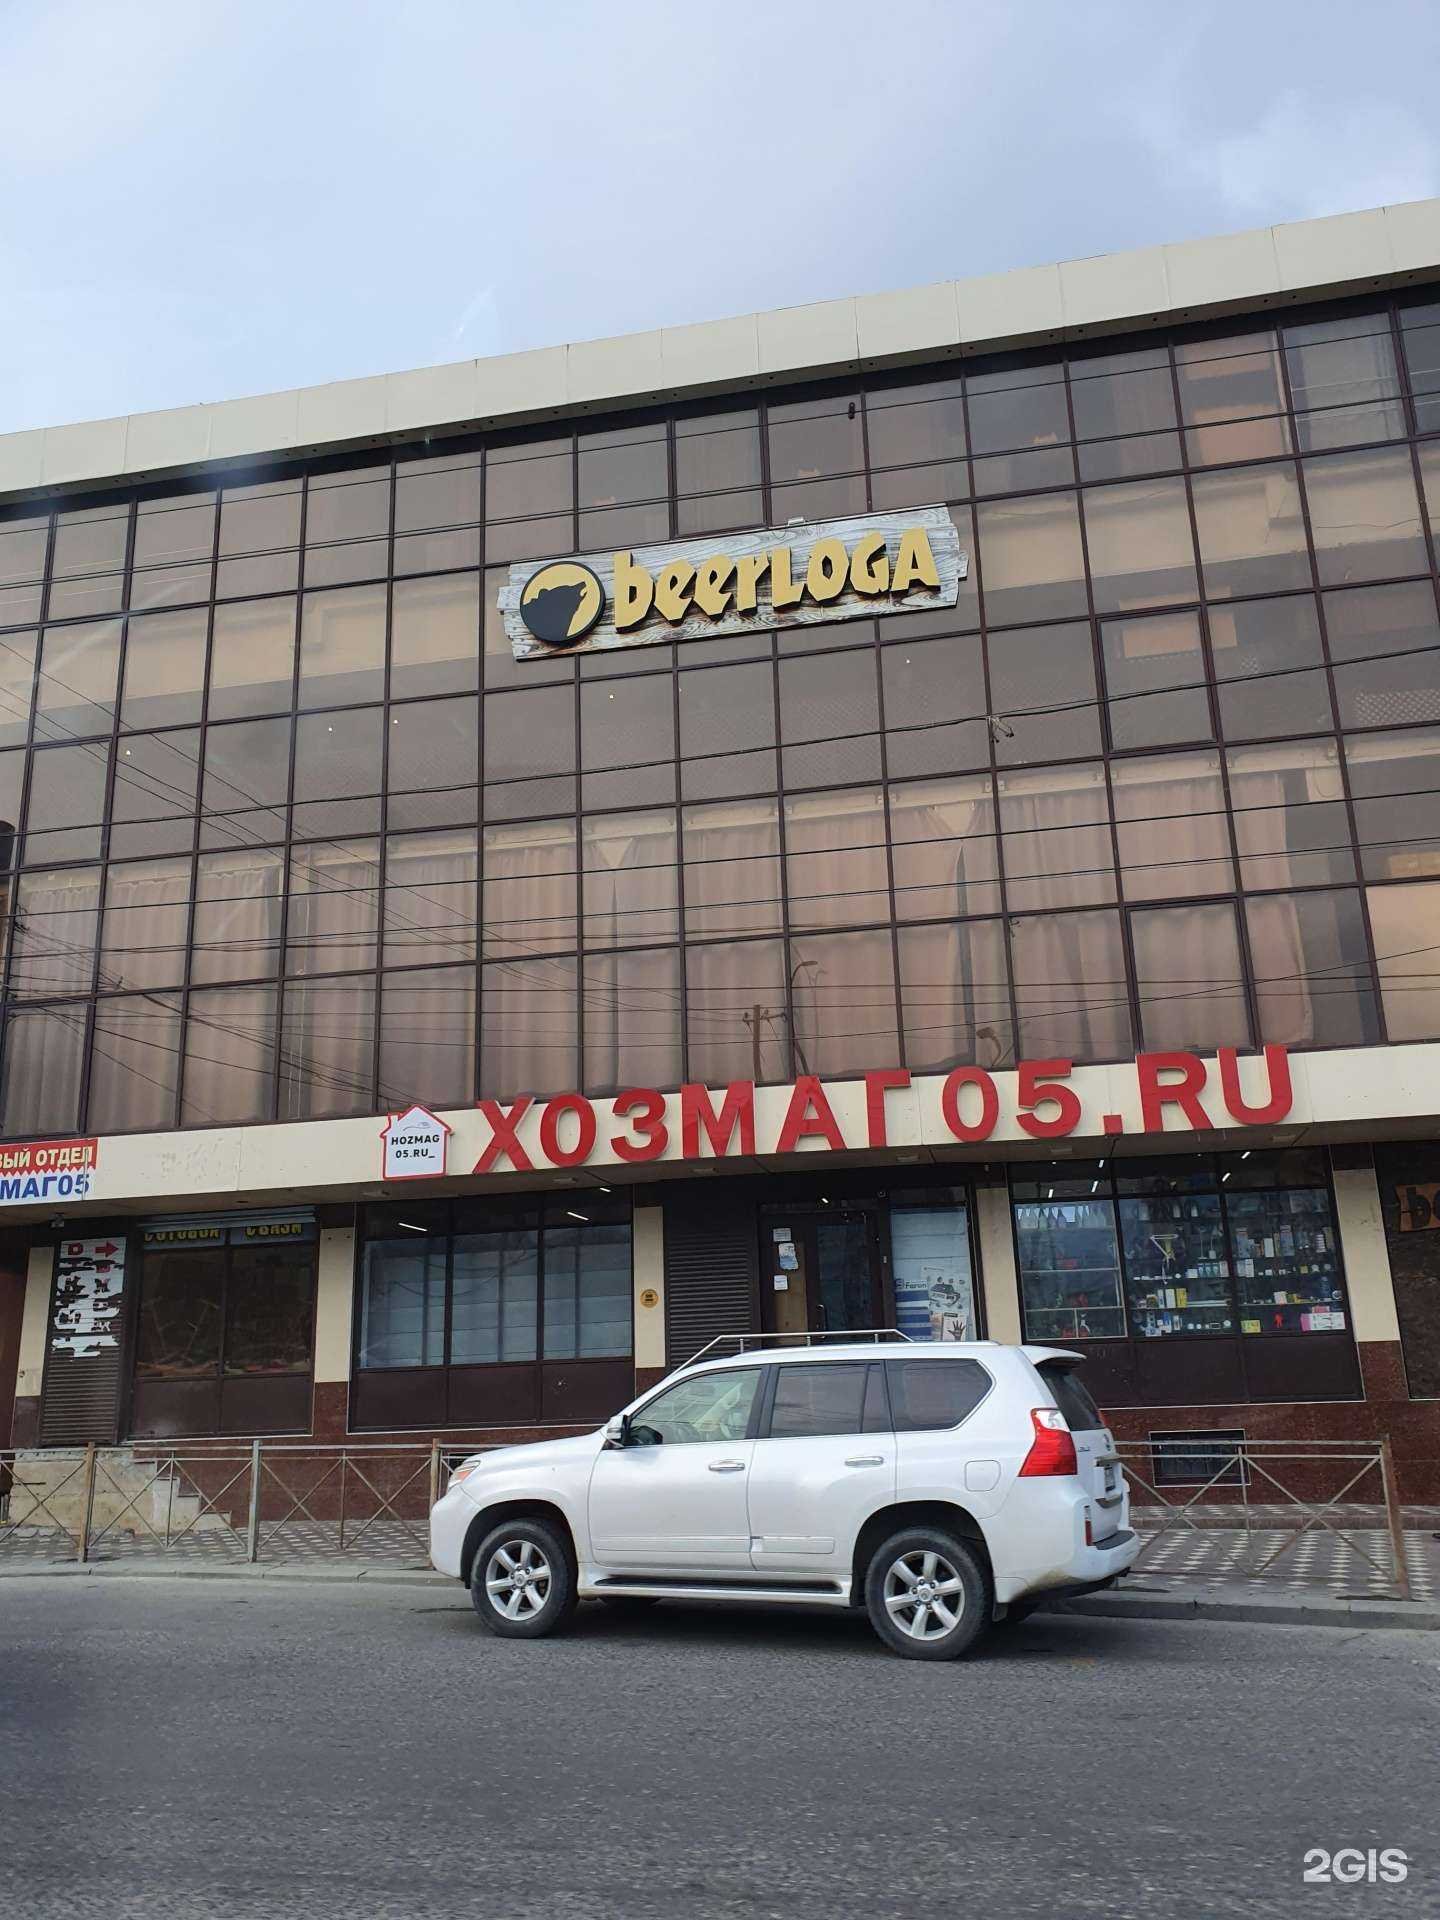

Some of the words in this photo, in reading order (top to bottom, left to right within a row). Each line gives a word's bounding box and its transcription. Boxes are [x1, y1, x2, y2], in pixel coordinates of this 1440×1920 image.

[391, 1134, 440, 1146] HOZMAG
[0, 1147, 31, 1169] ЫЙ
[35, 1145, 93, 1168] ОТДЕЛ
